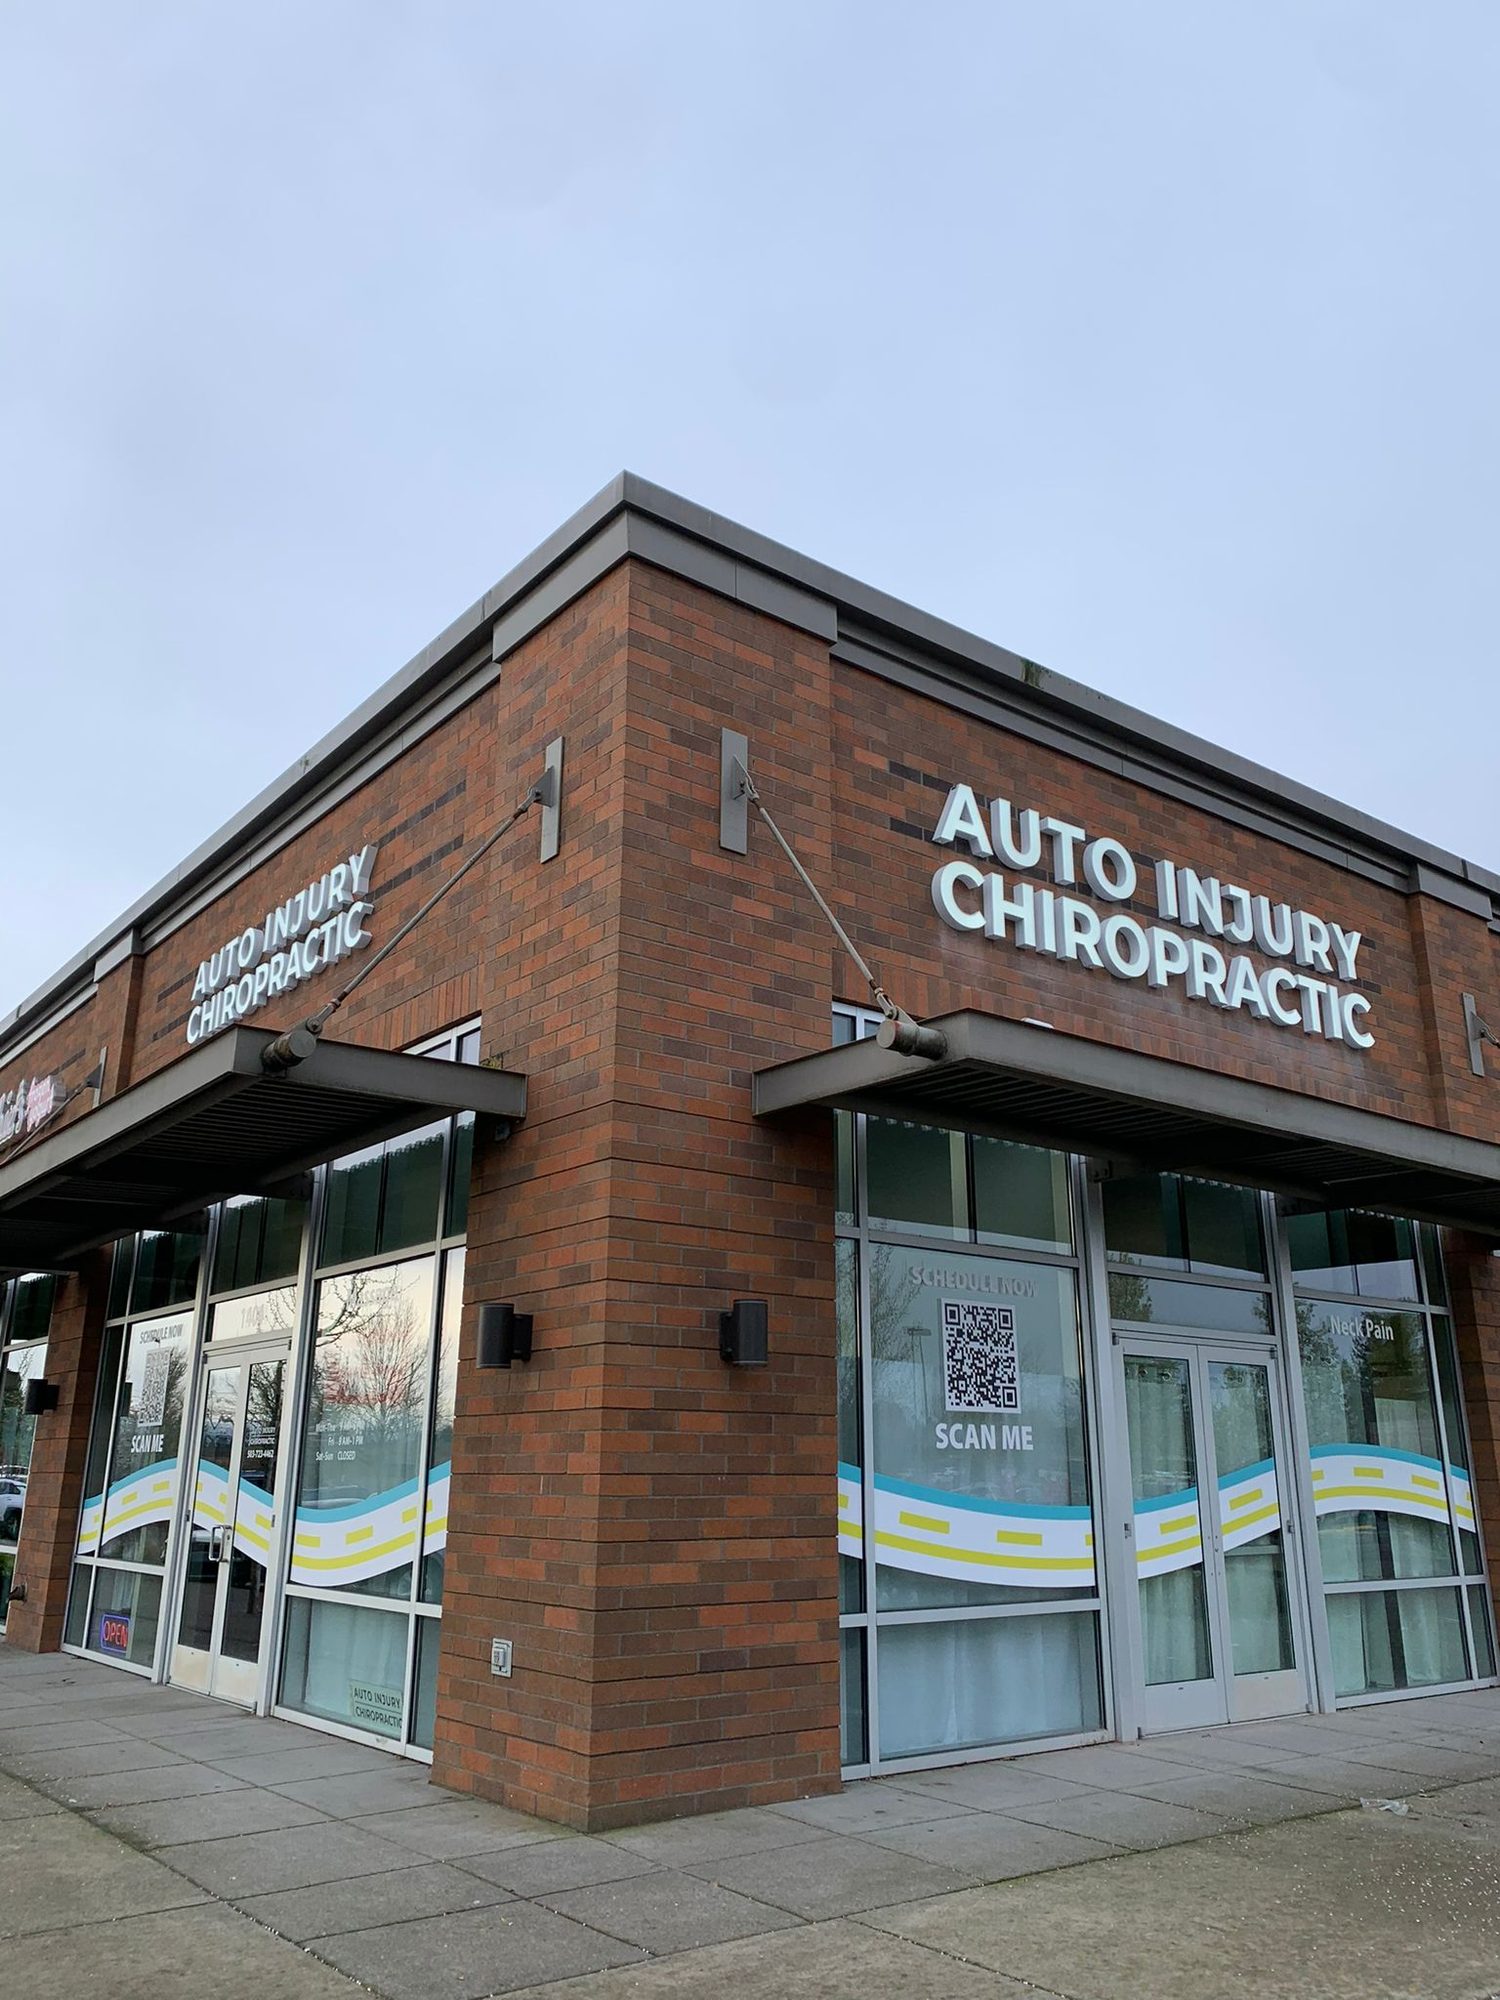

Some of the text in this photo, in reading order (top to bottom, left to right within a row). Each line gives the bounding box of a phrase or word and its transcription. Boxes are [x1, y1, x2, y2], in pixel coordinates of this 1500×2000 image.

[932, 783, 1362, 982] AUTO INJURY
[190, 844, 378, 1001] AUTO INJURY
[931, 861, 1376, 1050] CHIROPRACTIC
[187, 901, 374, 1045] CHIROPRACTIC
[909, 1265, 1040, 1298] SCHEDULE NOW
[140, 1324, 184, 1344] SCHEDULE NOW
[1330, 1314, 1394, 1340] Neck Pain
[131, 1433, 164, 1453] SCAN ME
[935, 1423, 1034, 1451] SCAN ME
[337, 1450, 356, 1461] CLOSED
[103, 1620, 128, 1648] OPEN
[354, 1687, 401, 1709] AUTO INJURY
